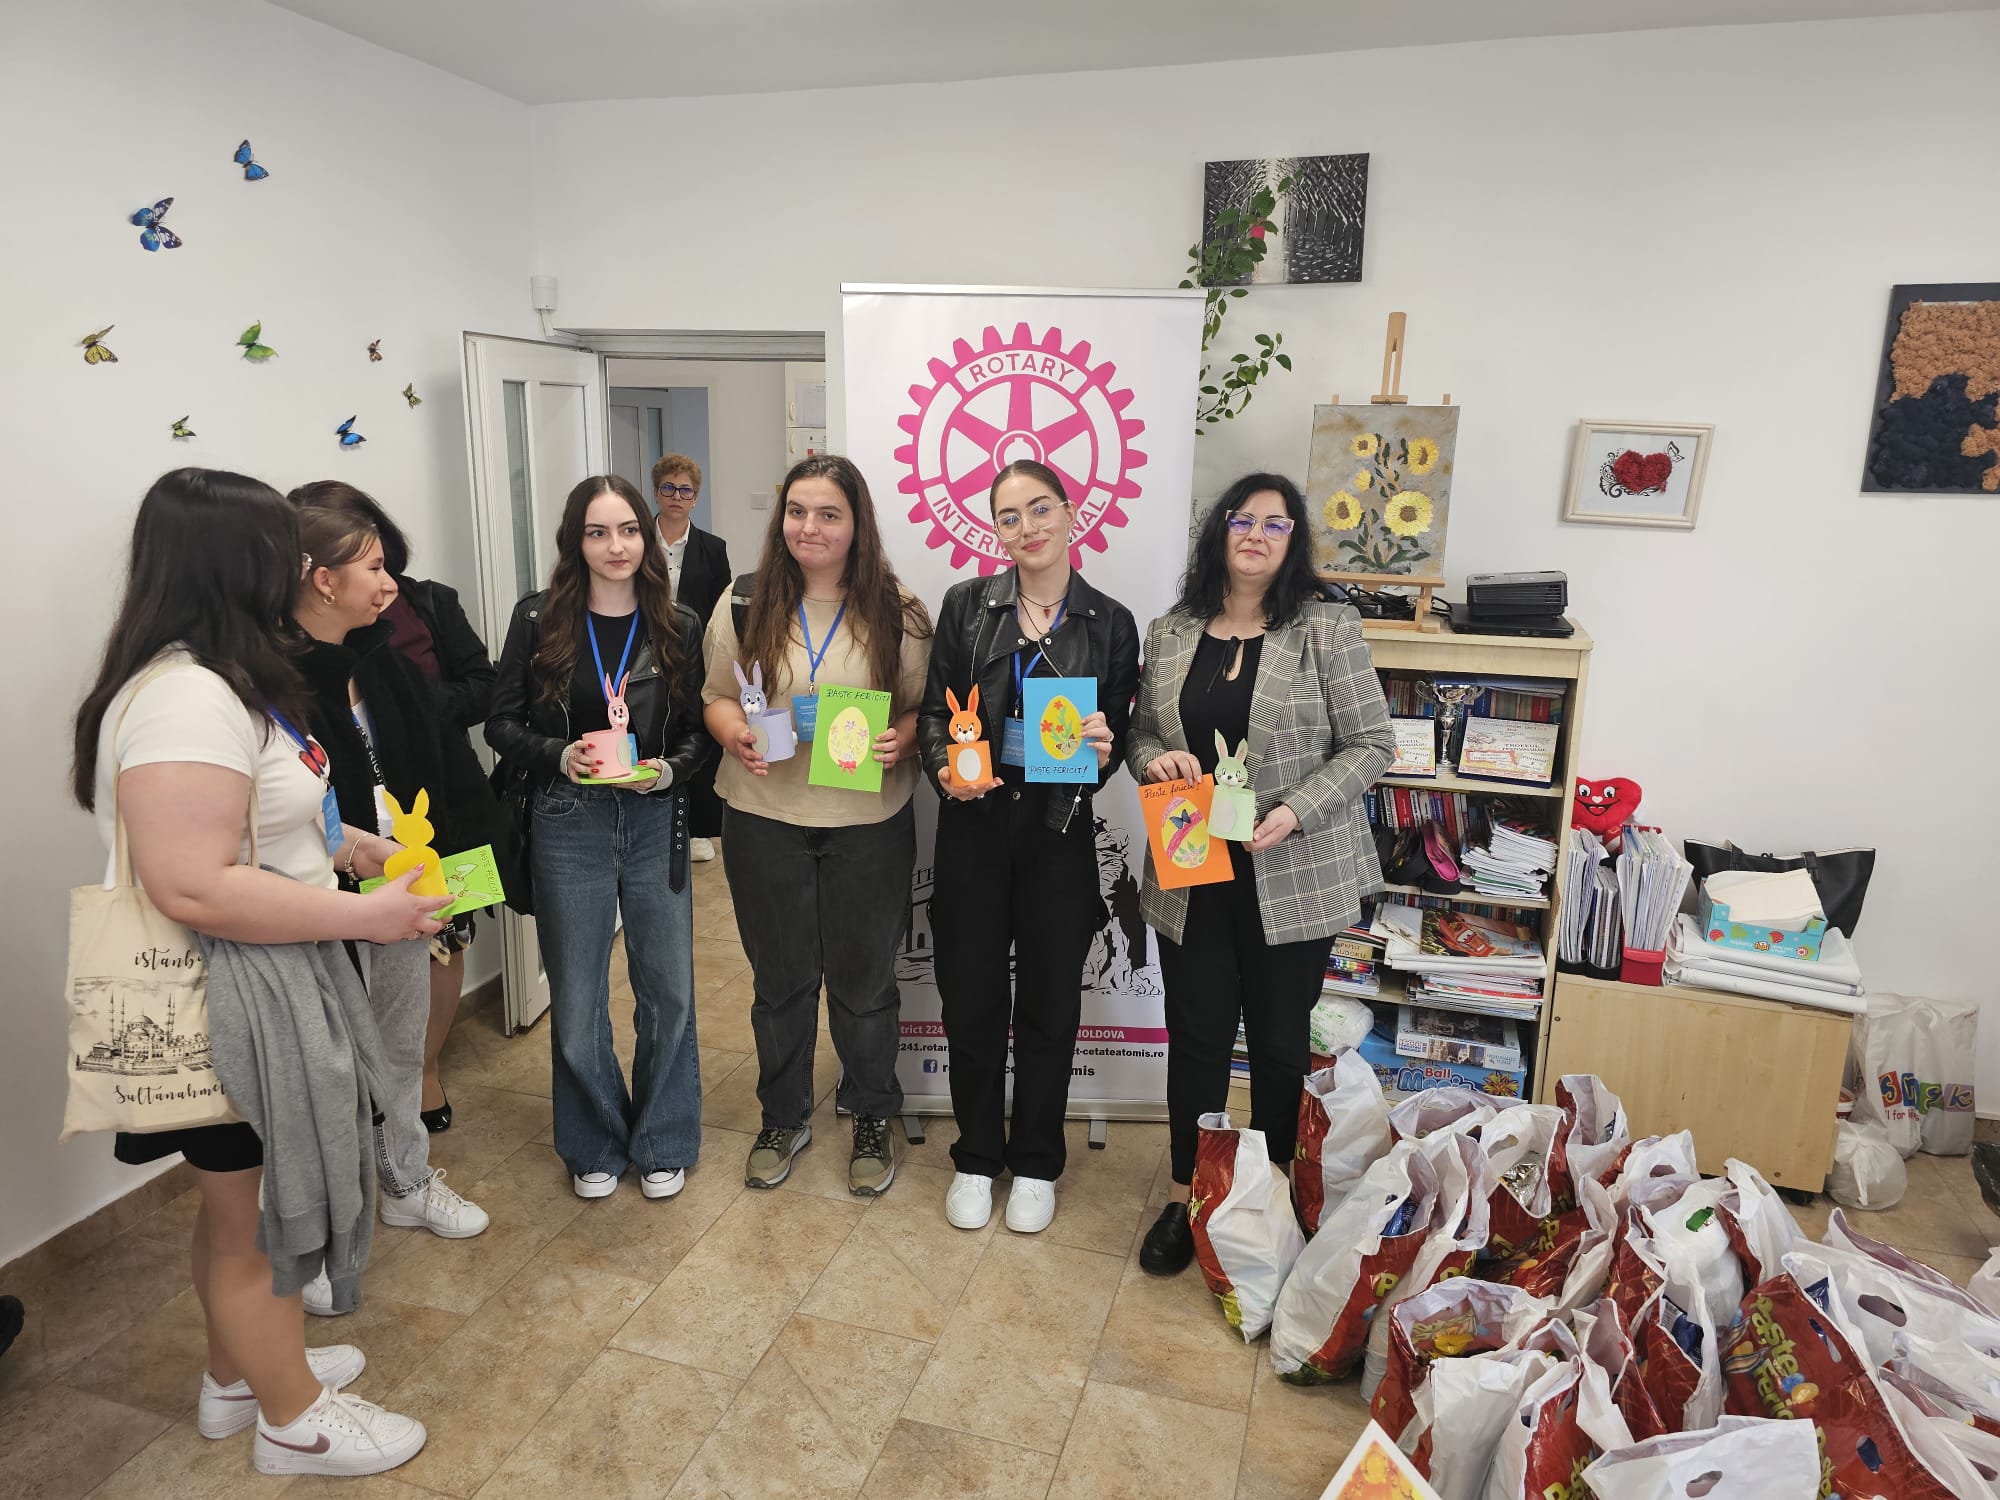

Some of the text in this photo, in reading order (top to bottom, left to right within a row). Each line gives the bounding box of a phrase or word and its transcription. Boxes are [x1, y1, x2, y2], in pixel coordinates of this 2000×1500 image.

[968, 353, 1075, 383] ROTARY
[135, 947, 202, 970] istanb
[900, 1025, 944, 1034] trict 224
[899, 1043, 948, 1052] 241.rotar
[1425, 1067, 1451, 1079] Ball
[1892, 1109, 1906, 1120] for
[1754, 1357, 1795, 1420] Feric
